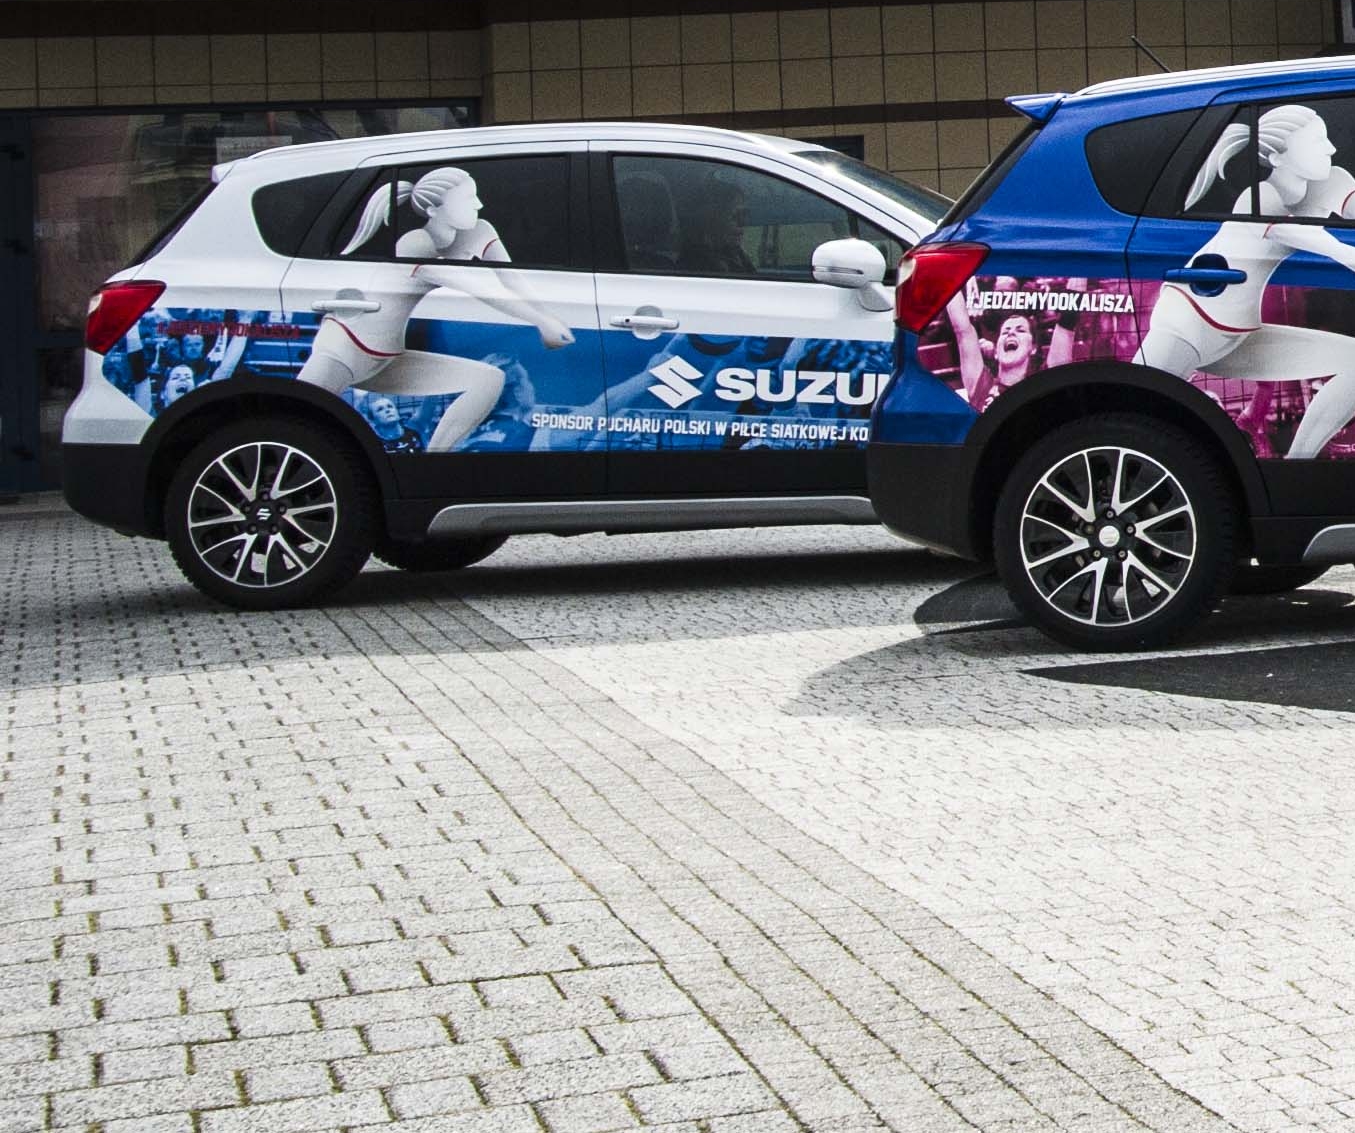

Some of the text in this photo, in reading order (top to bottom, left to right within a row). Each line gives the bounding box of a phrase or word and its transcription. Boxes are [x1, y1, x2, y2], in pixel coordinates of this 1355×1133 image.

[966, 291, 1135, 314] #JEDZIEMYDOKALISZA
[532, 413, 594, 431] SPONSOR
[664, 419, 711, 435] POLSKI
[715, 421, 727, 436] W
[771, 423, 847, 441] SIATKOWEJ
